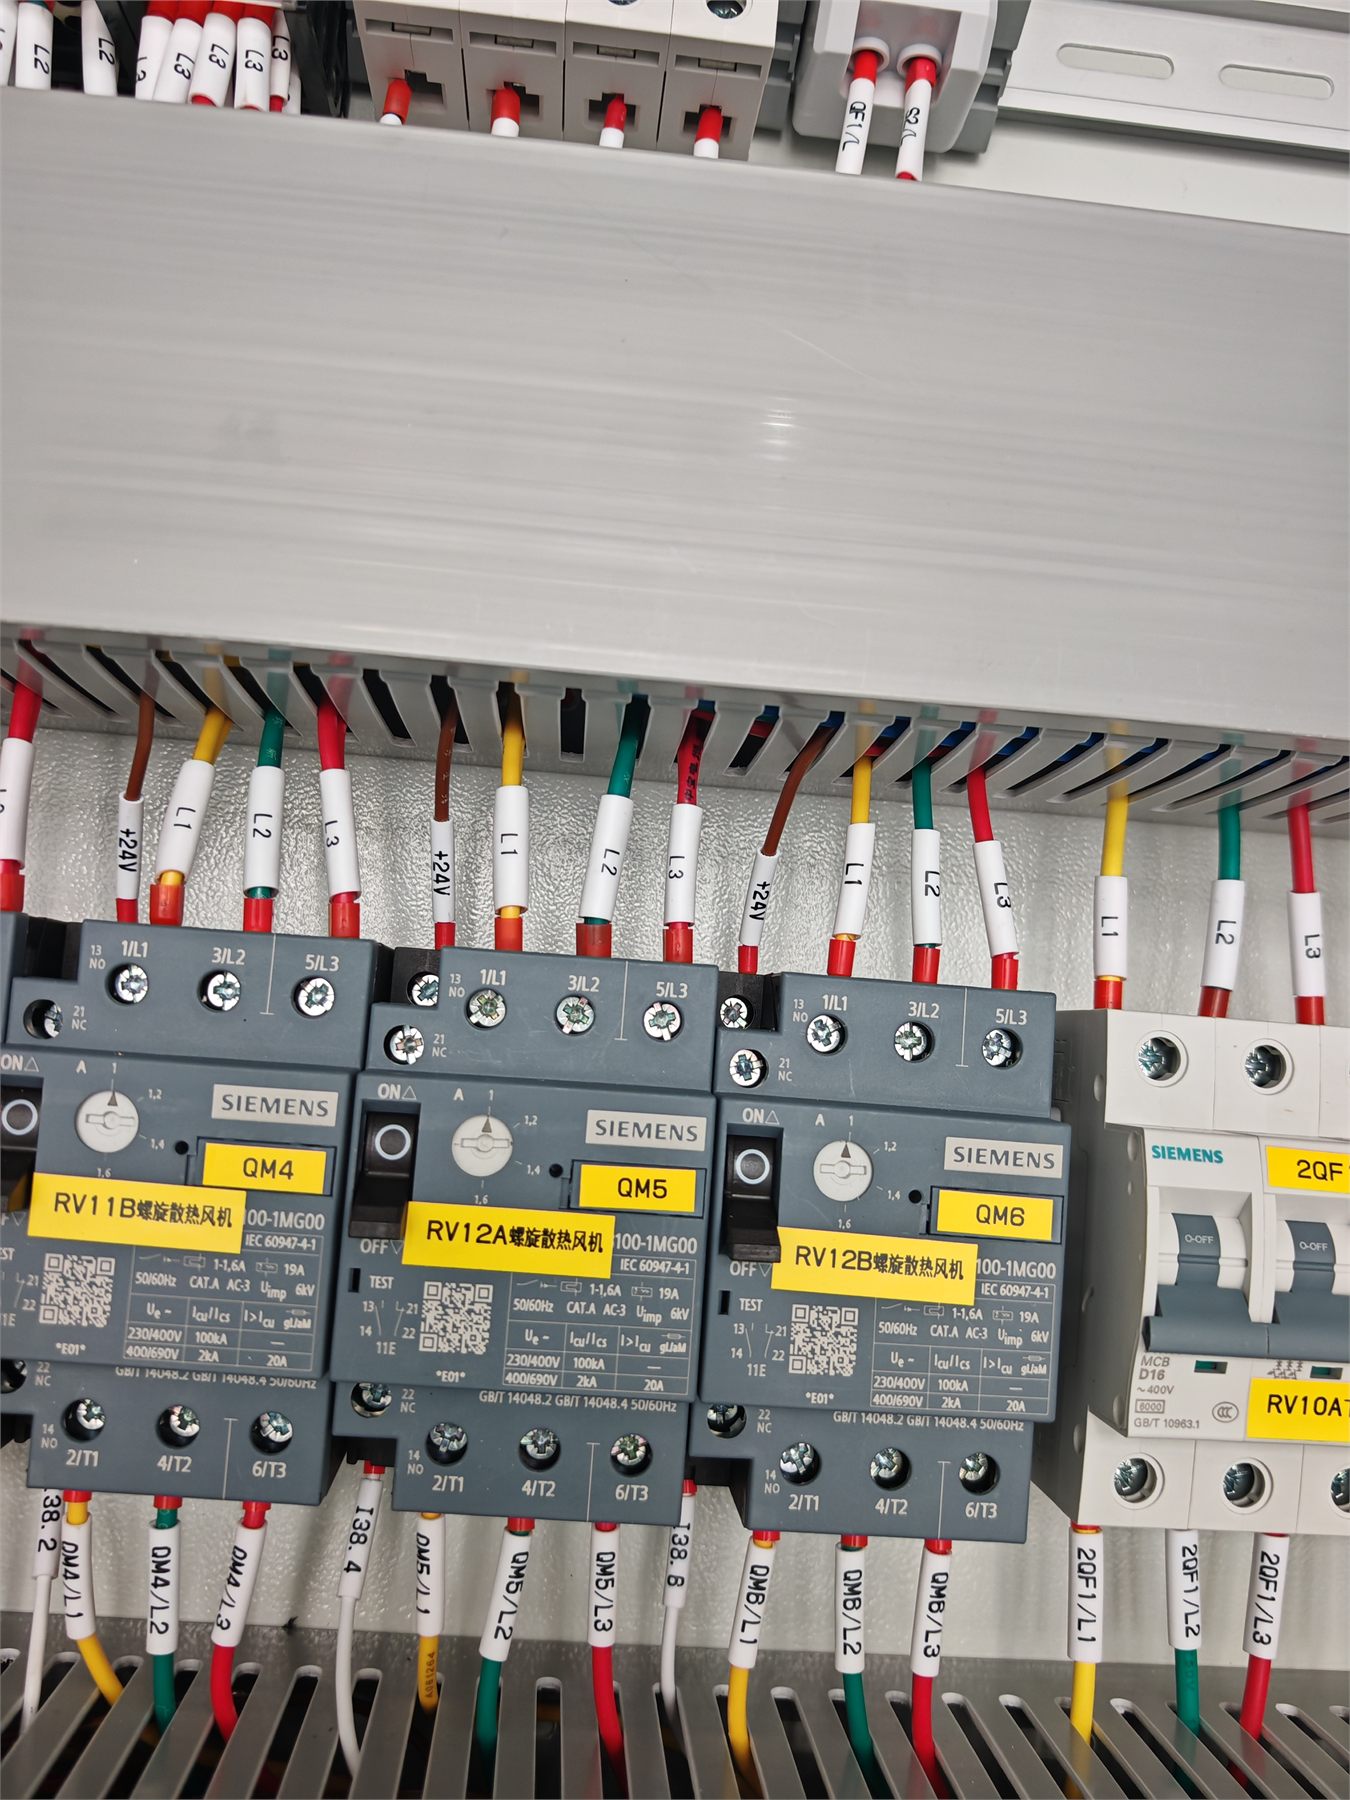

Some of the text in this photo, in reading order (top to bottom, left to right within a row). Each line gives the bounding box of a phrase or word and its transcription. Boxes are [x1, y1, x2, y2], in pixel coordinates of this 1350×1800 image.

[271, 35, 290, 61] L3
[34, 43, 50, 75] L2
[209, 43, 230, 70] L3
[244, 49, 265, 73] L3
[174, 52, 195, 80] L3
[173, 806, 196, 830] L1
[253, 813, 273, 839] L2
[324, 819, 340, 848] L3
[119, 828, 138, 873] +24V
[500, 832, 519, 856] L1
[601, 847, 621, 877] L2
[668, 855, 685, 880] L3
[432, 850, 451, 896] +24V
[844, 863, 864, 887] L1
[924, 870, 940, 897] L2
[749, 880, 771, 921] +24V
[994, 882, 1012, 908] L3
[1101, 915, 1119, 937] L1
[1215, 919, 1237, 945] L2
[90, 945, 102, 956] 13
[121, 940, 148, 958] 1/L1
[1304, 933, 1321, 959] L3
[89, 957, 106, 970] NO
[212, 947, 246, 965] 3/L2
[304, 954, 340, 972] 5/L3
[450, 973, 461, 984] 13
[480, 969, 506, 986] 1/L1
[568, 975, 600, 993] 3/L2
[448, 987, 465, 998] NO
[655, 981, 689, 999] 5/L3
[793, 999, 804, 1009] 13
[822, 994, 848, 1010] 1/L1
[908, 1002, 940, 1018] 3/L2
[72, 1005, 85, 1017] 21
[792, 1011, 808, 1023] NO
[995, 1009, 1028, 1025] 5/L3
[72, 1018, 87, 1031] NC
[433, 1033, 445, 1045] 21
[432, 1047, 447, 1058] NC
[0, 1054, 23, 1071] ON
[778, 1058, 790, 1068] 21
[778, 1071, 793, 1081] NC
[377, 1083, 401, 1100] ON
[221, 1094, 329, 1117] SIEMENS
[742, 1107, 764, 1124] ON
[595, 1119, 698, 1142] SIEMENS
[953, 1146, 1055, 1169] SIEMENS
[1151, 1145, 1224, 1164] SIEMENS
[243, 1157, 294, 1180] QM4
[1297, 1159, 1350, 1181] 2QF
[617, 1177, 668, 1199] QM5
[976, 1204, 1025, 1226] QM6
[245, 1234, 317, 1250] IEC 60947-4-1
[360, 1239, 389, 1254] OFF
[284, 1263, 305, 1276] 19A
[620, 1258, 690, 1274] IEC 60947-4-1
[729, 1261, 758, 1277] OFF
[135, 1272, 177, 1288] 50/60Hz
[226, 1279, 251, 1293] AC-3
[369, 1275, 394, 1289] TEST
[659, 1287, 679, 1300] 19A
[981, 1283, 1049, 1298] IEC 60947-4-1
[513, 1298, 554, 1313] 50/60Hz
[603, 1304, 627, 1317] AC-3
[739, 1298, 763, 1312] TEST
[1019, 1311, 1039, 1323] 19A
[127, 1327, 183, 1343] 230/400V
[878, 1322, 918, 1336] 50/60Hz
[965, 1327, 988, 1340] AC-3
[195, 1331, 228, 1345] 100kA
[126, 1346, 179, 1361] 400/690V
[198, 1350, 220, 1363] 2kA
[266, 1354, 288, 1367] 20A
[506, 1353, 561, 1369] 230/400V
[1140, 1355, 1170, 1367] MCB
[573, 1357, 605, 1371] 100kA
[35, 1375, 51, 1387] NC
[505, 1372, 558, 1387] 400/690V
[576, 1376, 598, 1388] 2kA
[1139, 1368, 1166, 1381] D16
[643, 1379, 664, 1392] 20A
[873, 1376, 925, 1391] 230/400V
[938, 1379, 968, 1392] 100kA
[400, 1402, 416, 1413] NC
[479, 1390, 677, 1413] GB/T 14048.2 GB/T 14048.4 50/60Hz
[872, 1394, 923, 1408] 400/690V
[941, 1397, 961, 1409] 2kA
[1006, 1400, 1026, 1413] 20A
[1139, 1402, 1162, 1411] 6000
[42, 1423, 55, 1435] 14
[757, 1422, 772, 1433] NC
[861, 1413, 903, 1427] 14048.2
[934, 1417, 977, 1430] 14048.4
[980, 1418, 1024, 1432] 50/60Hz
[1134, 1417, 1200, 1429] GB/T 10963.1
[41, 1437, 58, 1449] NO
[66, 1449, 99, 1468] 2/T1
[408, 1450, 421, 1461] 14
[156, 1455, 192, 1473] 4/T2
[252, 1461, 287, 1478] 6/T3
[407, 1463, 424, 1475] NO
[765, 1469, 776, 1480] 14
[432, 1475, 464, 1492] 2/T1
[521, 1480, 556, 1497] 4/T2
[764, 1483, 780, 1494] NO
[615, 1483, 649, 1501] 6/T3
[788, 1494, 819, 1511] 2/T1
[875, 1499, 908, 1515] 4/T2
[965, 1502, 998, 1519] 6/T3
[149, 1546, 171, 1635] QM4/L2
[494, 1551, 530, 1641] QM5/L2
[593, 1552, 616, 1632] QM5/L3
[1077, 1548, 1097, 1643] 2QF1/L1
[1181, 1544, 1200, 1638] 2QF1/L2
[1252, 1550, 1280, 1646] 2QF1/L3
